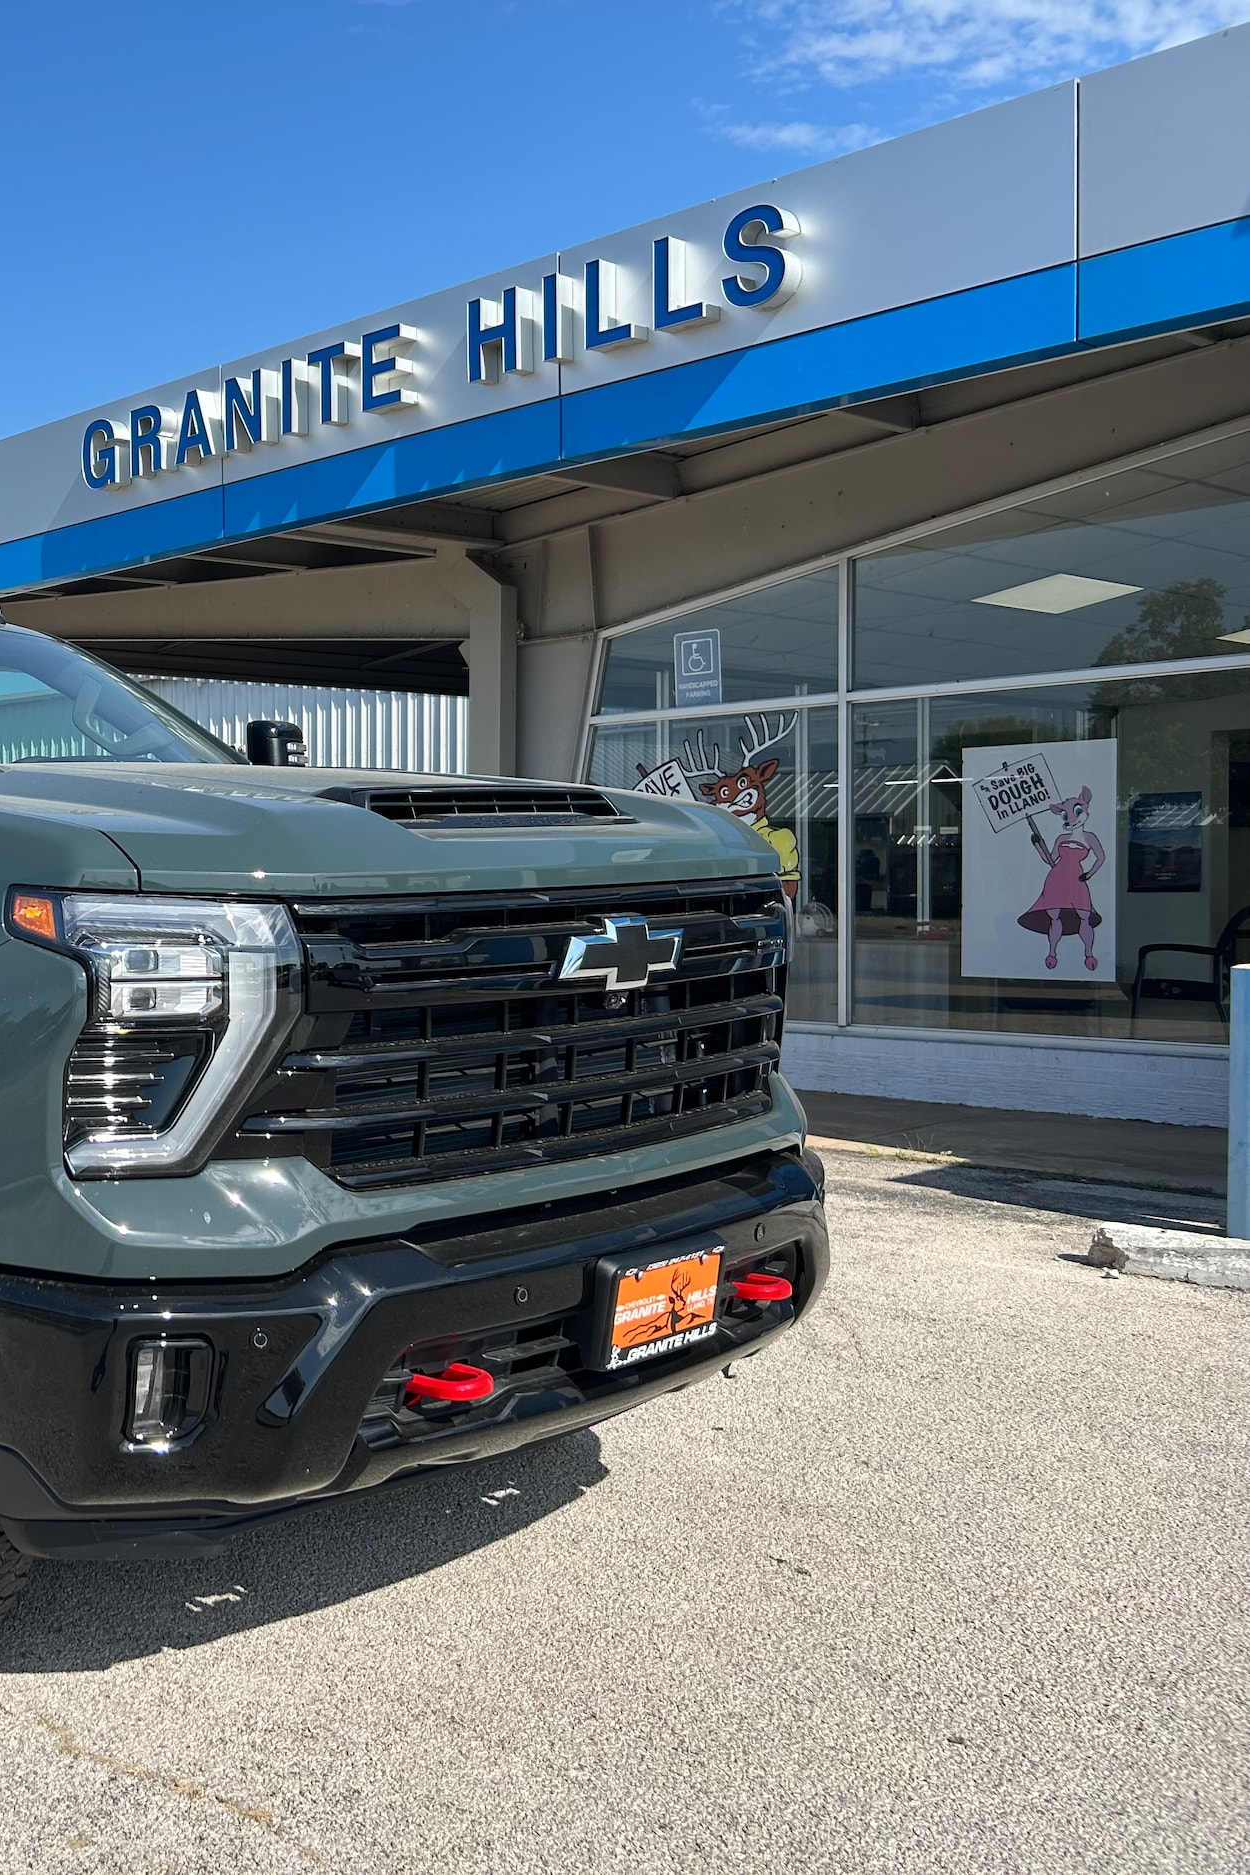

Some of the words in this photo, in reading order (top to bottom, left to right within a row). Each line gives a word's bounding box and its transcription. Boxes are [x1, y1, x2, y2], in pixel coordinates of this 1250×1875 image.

[81, 323, 419, 492] GRANITE
[467, 203, 802, 385] HILLS
[678, 680, 718, 690] HANDICAPPED
[685, 690, 711, 698] PARKING
[637, 765, 681, 795] AVE
[991, 774, 1016, 790] Save
[1016, 763, 1035, 778] BIG
[987, 773, 1045, 811] DOUGH
[1008, 789, 1051, 815] LLANO!
[614, 1301, 667, 1326] GRANITE
[686, 1285, 717, 1305] HILLS
[625, 1295, 657, 1310] CHEVROLET
[627, 1332, 685, 1362] GRANITE
[683, 1321, 718, 1345] HILLS
